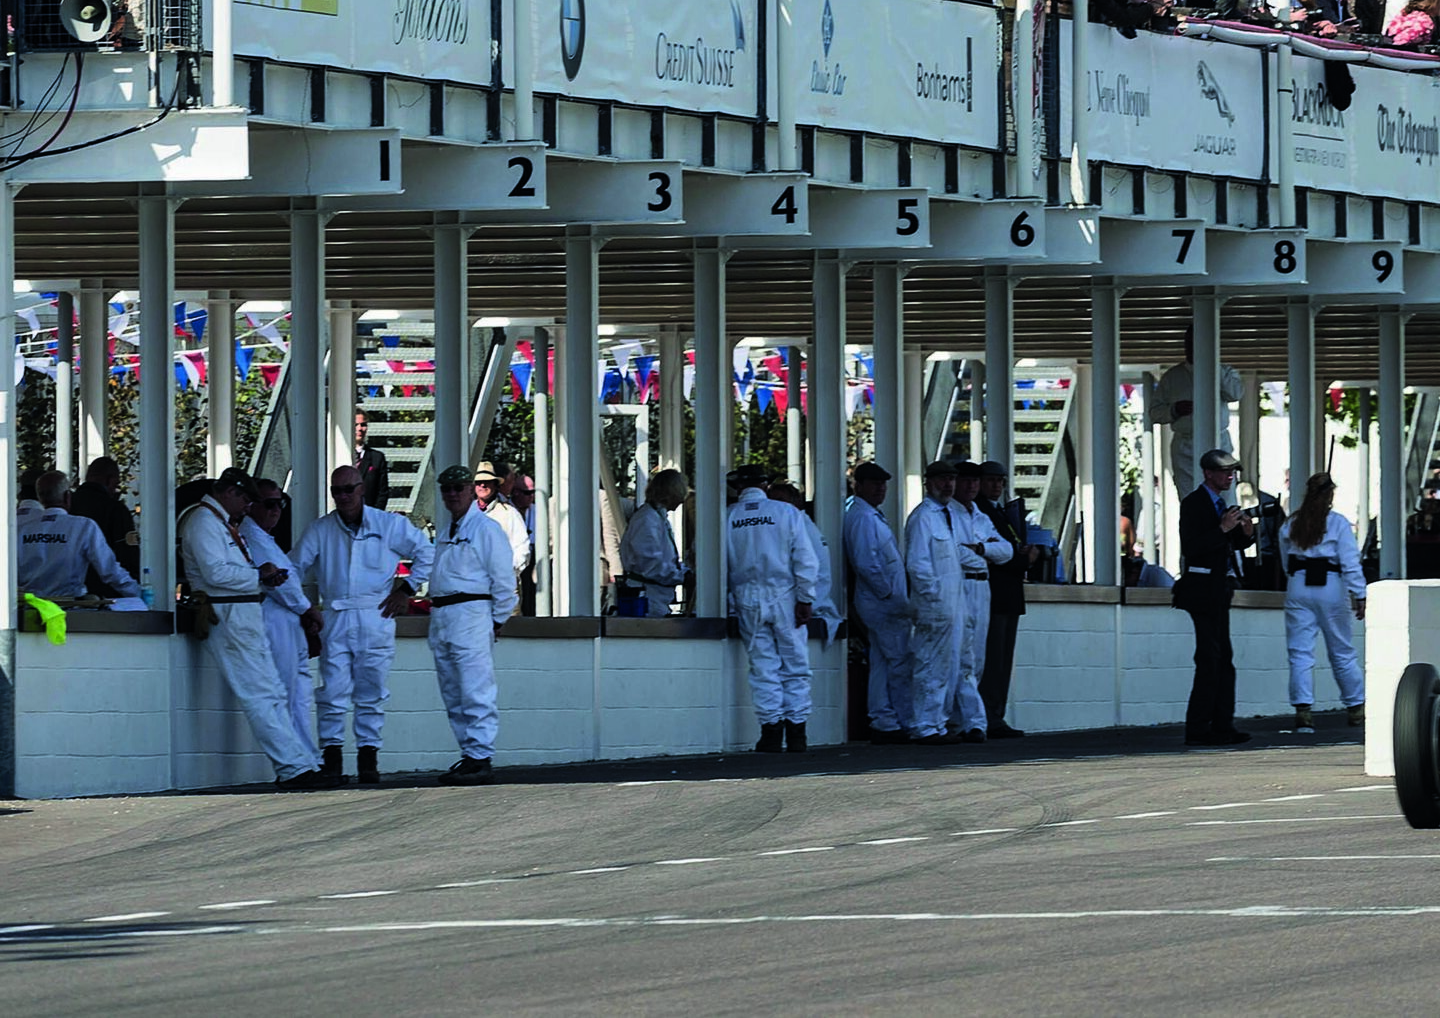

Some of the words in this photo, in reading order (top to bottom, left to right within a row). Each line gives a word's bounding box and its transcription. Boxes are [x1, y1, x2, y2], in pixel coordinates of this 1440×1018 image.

[655, 32, 695, 82] CREDIT
[696, 37, 735, 88] SUISSE
[916, 62, 965, 104] Bonhams
[380, 140, 390, 182] 1
[1194, 134, 1237, 156] JAGUAR
[507, 157, 535, 197] 2
[647, 172, 672, 212] 3
[771, 186, 798, 224] 4
[895, 199, 920, 236] 5
[1010, 211, 1034, 247] 6
[1171, 230, 1195, 264] 7
[1273, 240, 1297, 274] 8
[1371, 250, 1394, 283] 9
[22, 533, 68, 544] MARSHAL
[731, 516, 776, 529] MARSHAL
